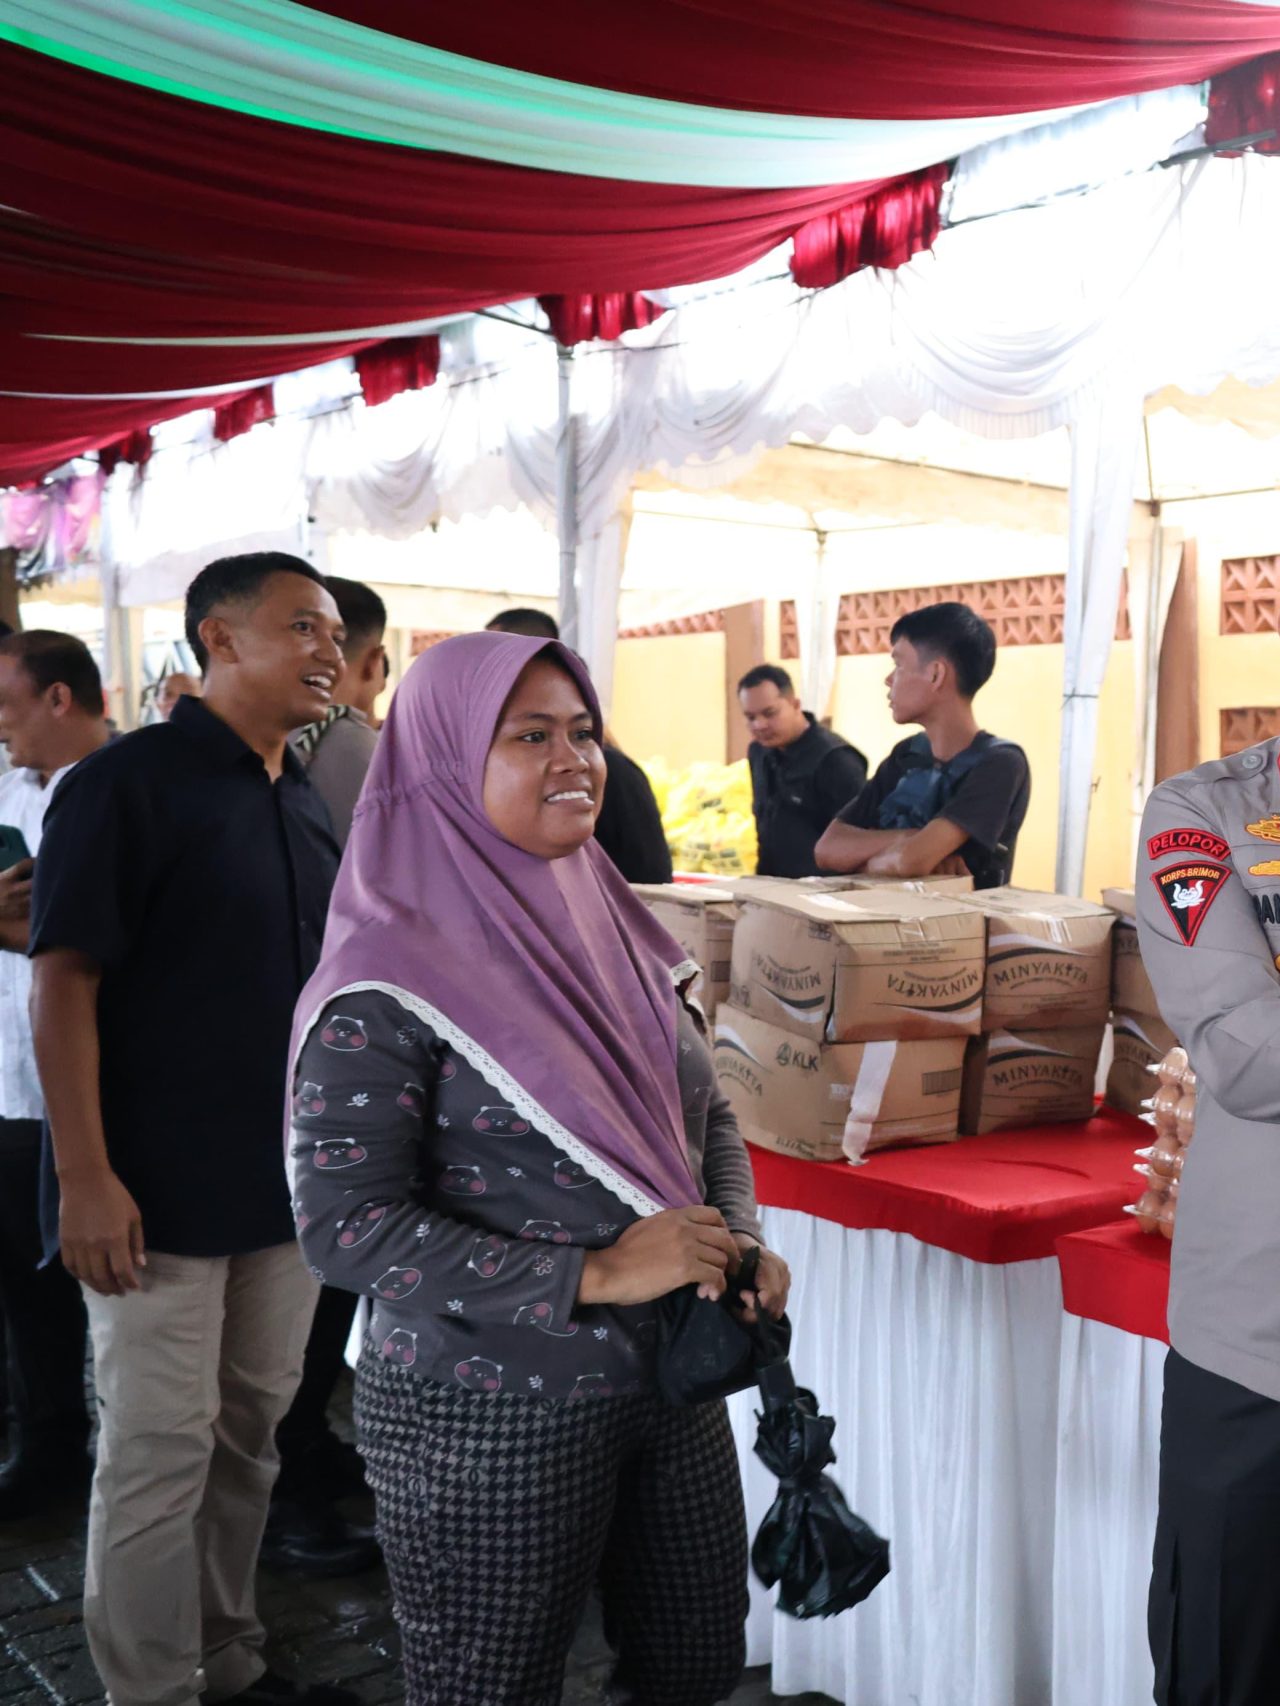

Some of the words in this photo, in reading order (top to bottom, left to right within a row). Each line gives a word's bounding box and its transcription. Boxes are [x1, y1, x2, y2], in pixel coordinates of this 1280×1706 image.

[1151, 831, 1226, 855] PELOPOR
[1187, 867, 1220, 879] BRIMOB
[887, 970, 979, 998] MINYAKITA
[993, 962, 1088, 986] MINYAKITA
[793, 1050, 819, 1071] KLK
